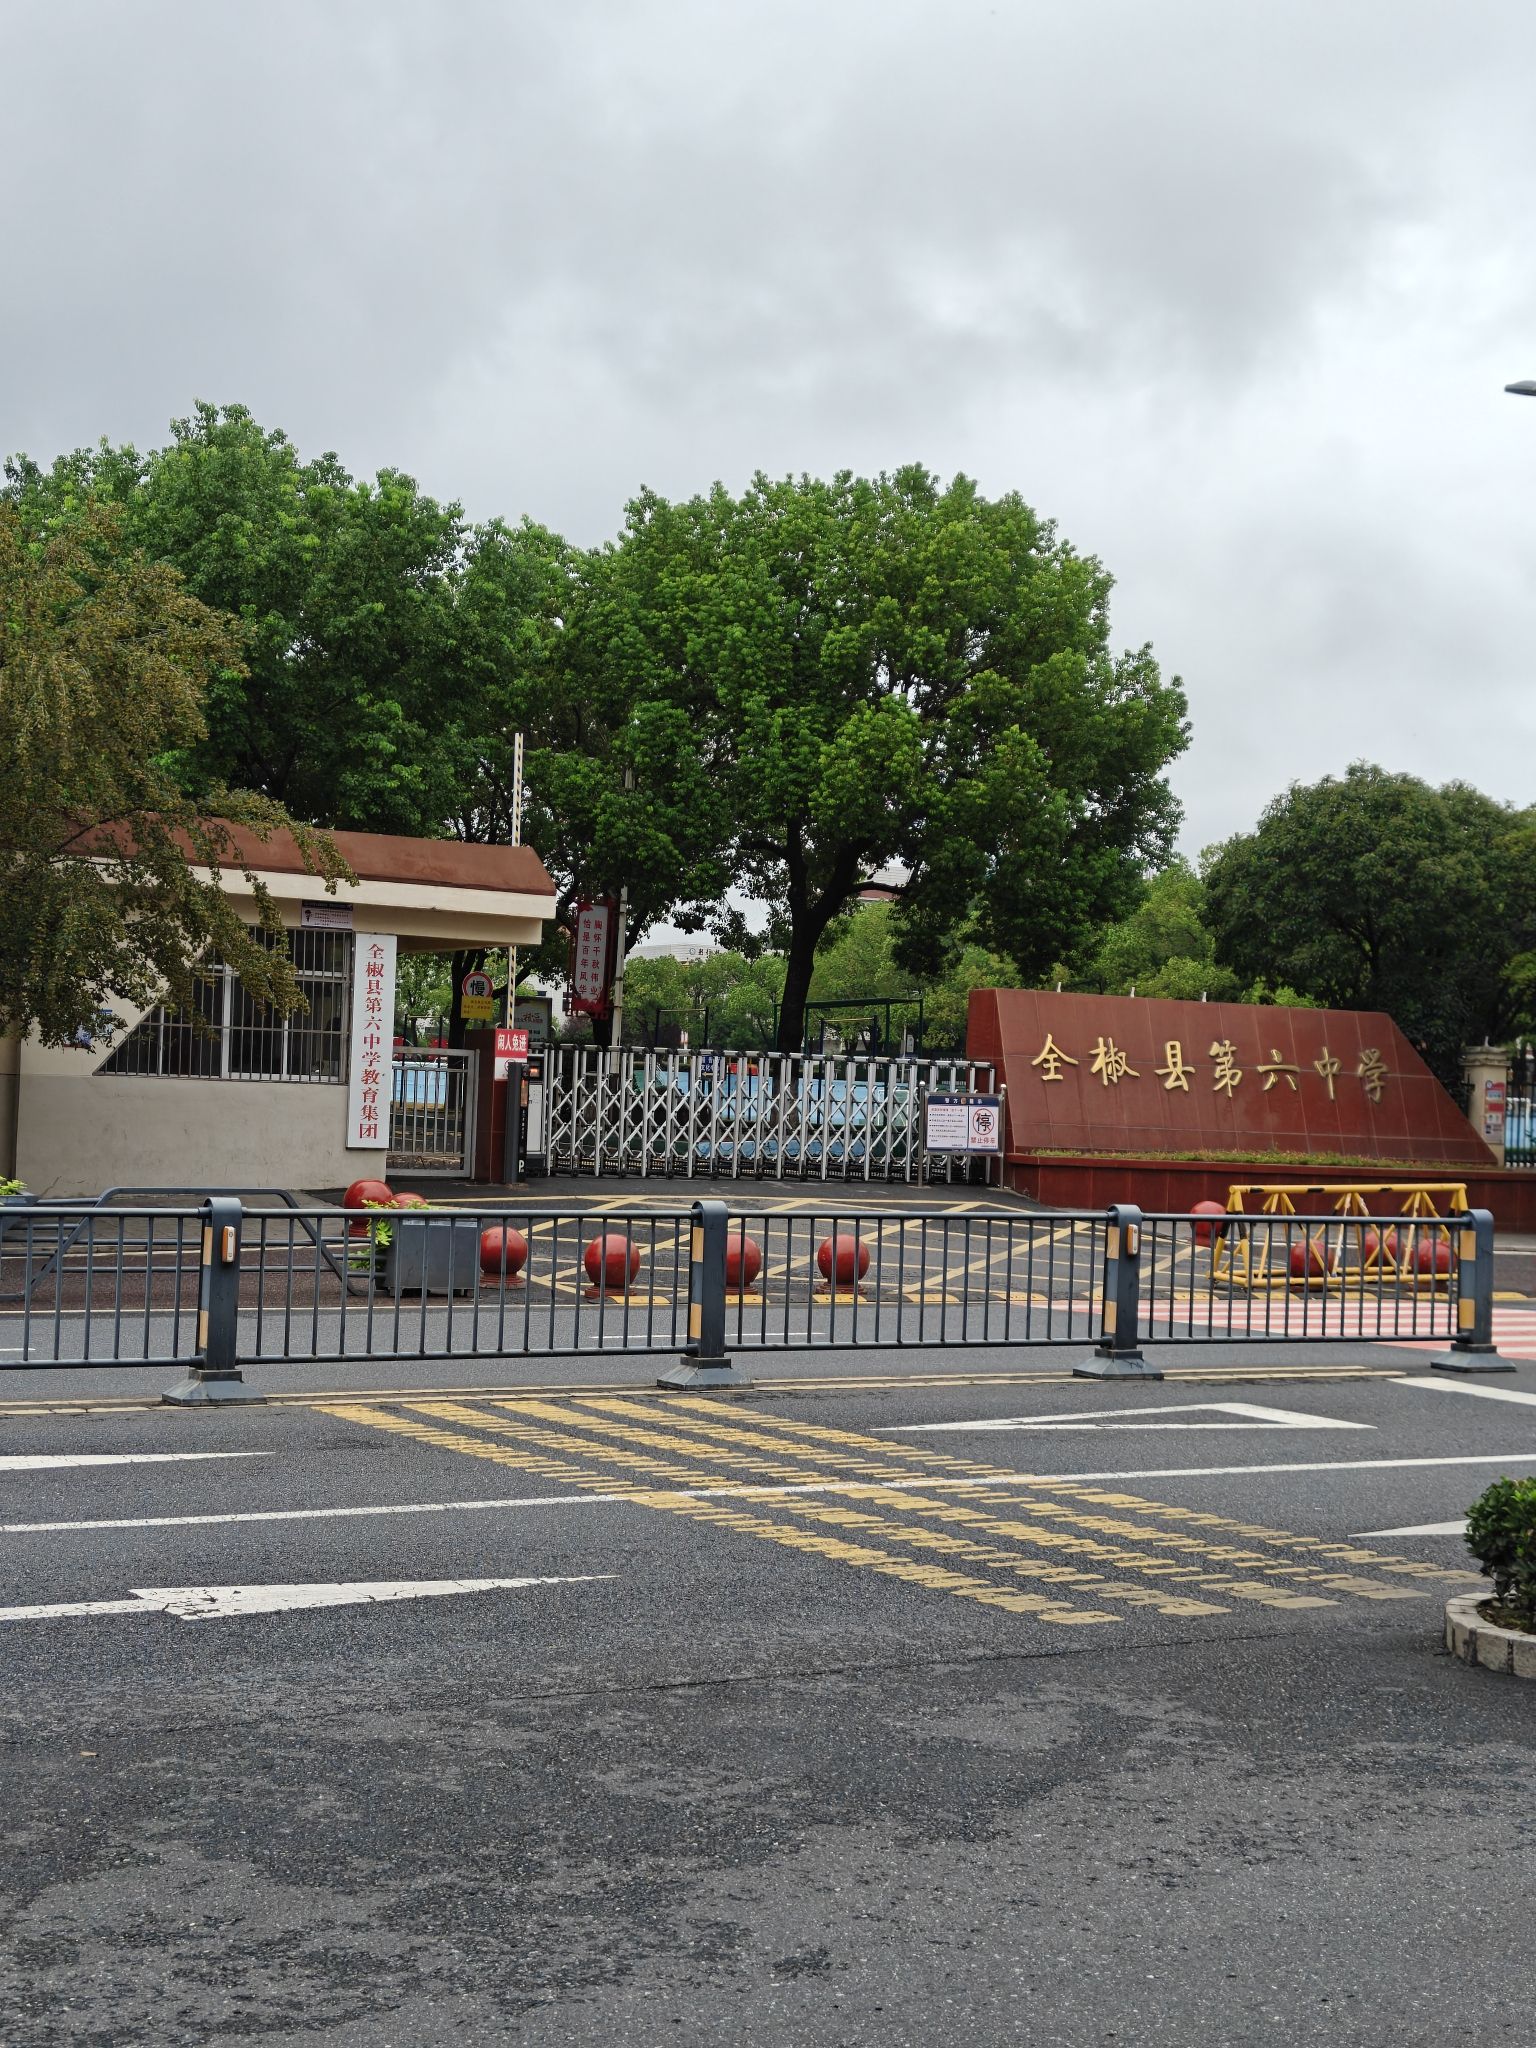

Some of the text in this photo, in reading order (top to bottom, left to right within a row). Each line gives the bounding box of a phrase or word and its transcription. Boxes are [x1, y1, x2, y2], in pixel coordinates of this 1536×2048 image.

[470, 979, 486, 997] 慢
[359, 943, 385, 1140] 全椒县第六中学教育集团
[497, 1033, 527, 1051] 闲人免进
[1031, 1033, 1390, 1104] 全椒县第六中学
[970, 1136, 996, 1144] 禁止停车
